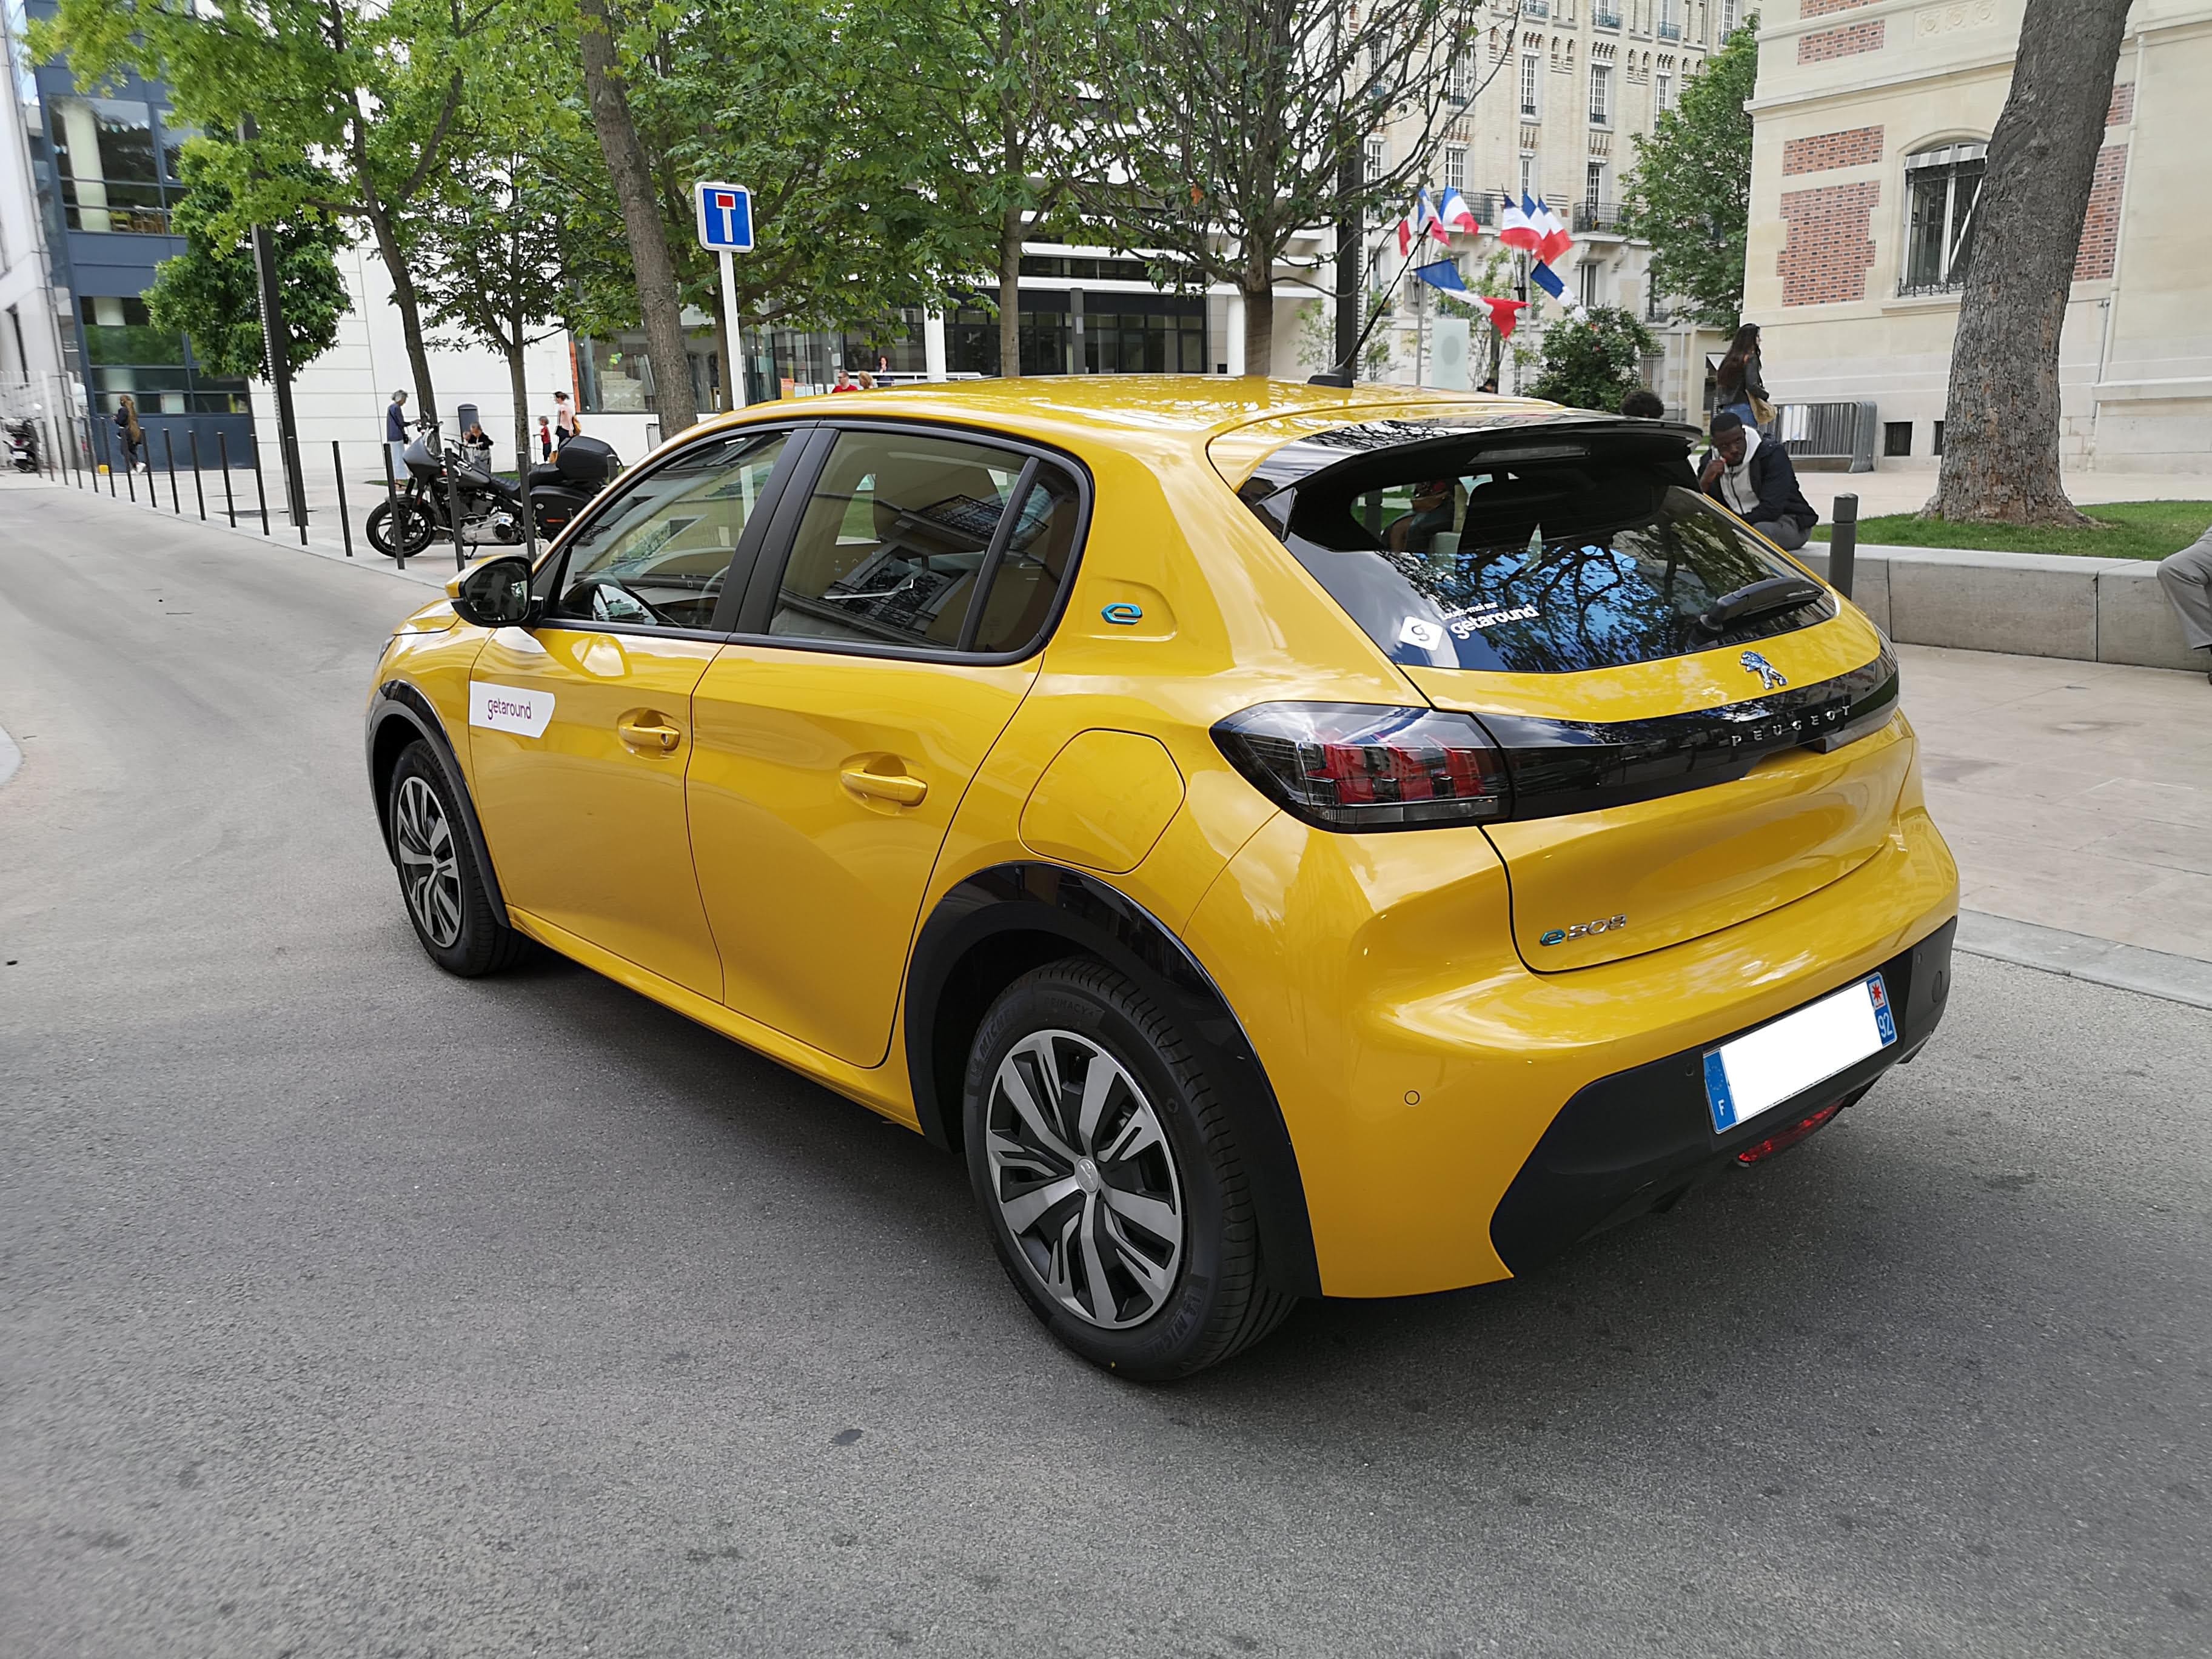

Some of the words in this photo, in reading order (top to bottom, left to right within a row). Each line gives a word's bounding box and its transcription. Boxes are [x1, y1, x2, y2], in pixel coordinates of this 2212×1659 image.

[1450, 603, 1540, 640] getaround
[488, 698, 532, 720] getaround
[1731, 705, 1850, 747] PEUGEOT
[1877, 1012, 1893, 1038] 92
[1717, 1099, 1725, 1116] F
